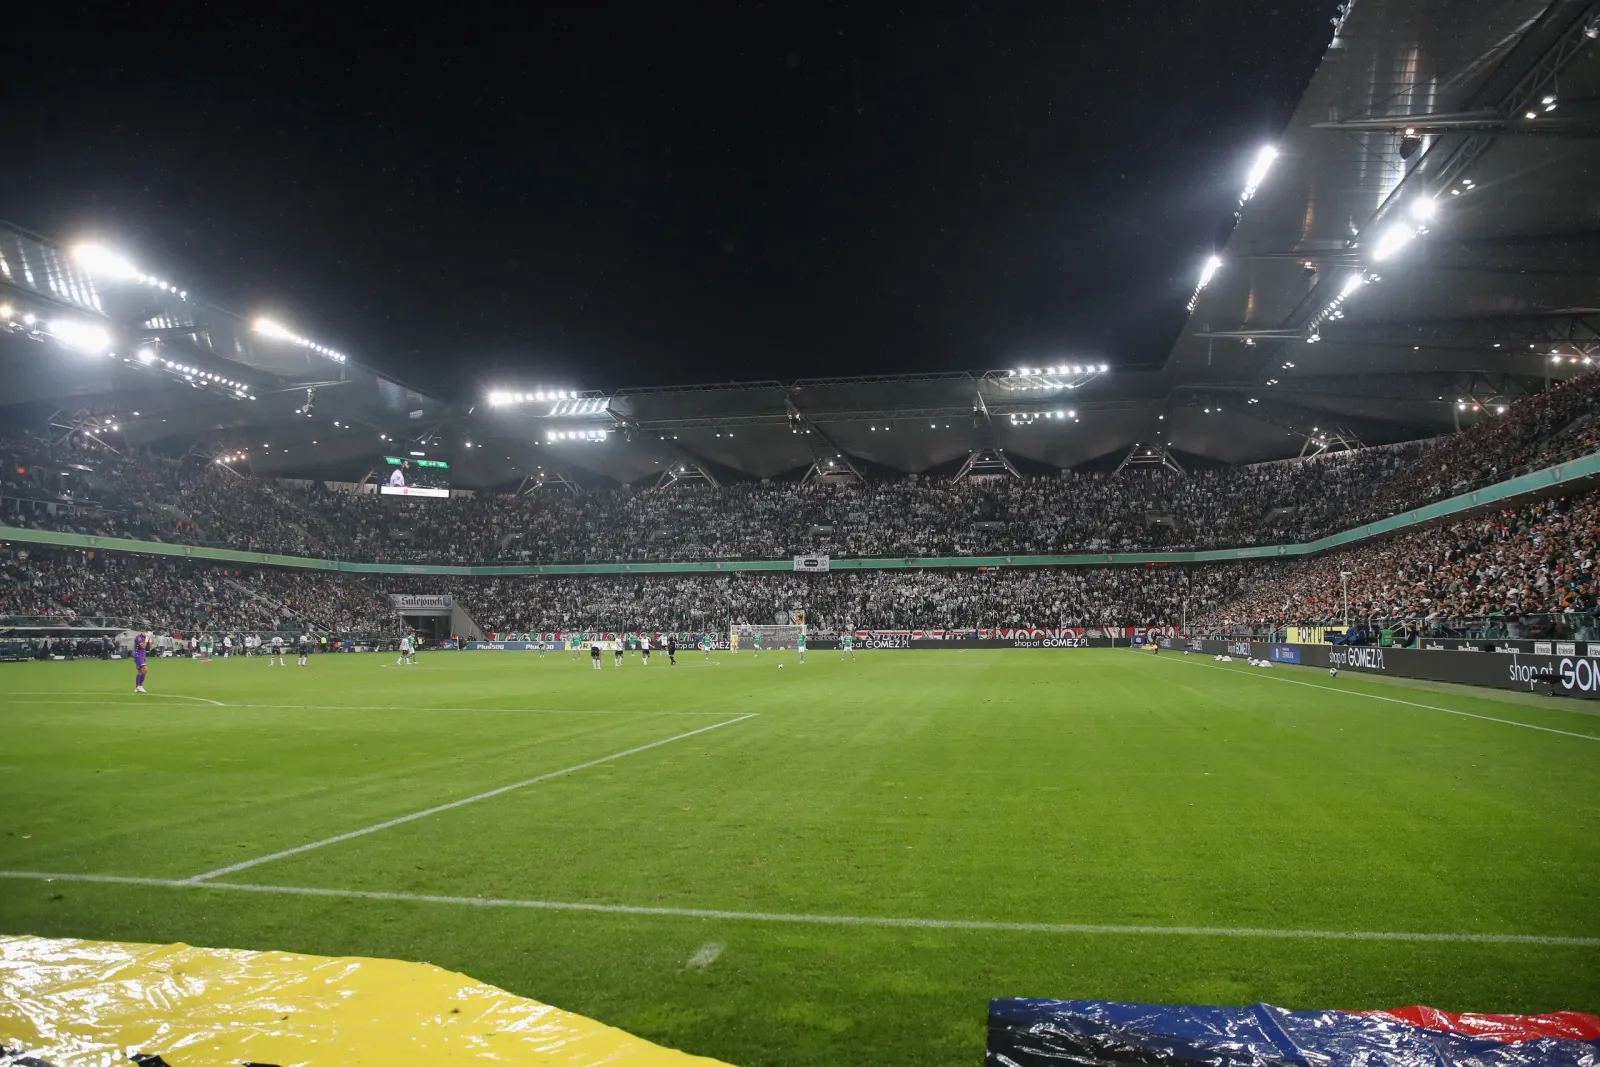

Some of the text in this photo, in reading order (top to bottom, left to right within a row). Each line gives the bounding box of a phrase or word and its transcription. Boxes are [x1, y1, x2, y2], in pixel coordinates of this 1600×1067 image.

[674, 641, 687, 650] hop
[1015, 640, 1031, 648] shop
[1329, 646, 1341, 668] shop
[1341, 650, 1347, 663] at
[1509, 653, 1538, 690] shop
